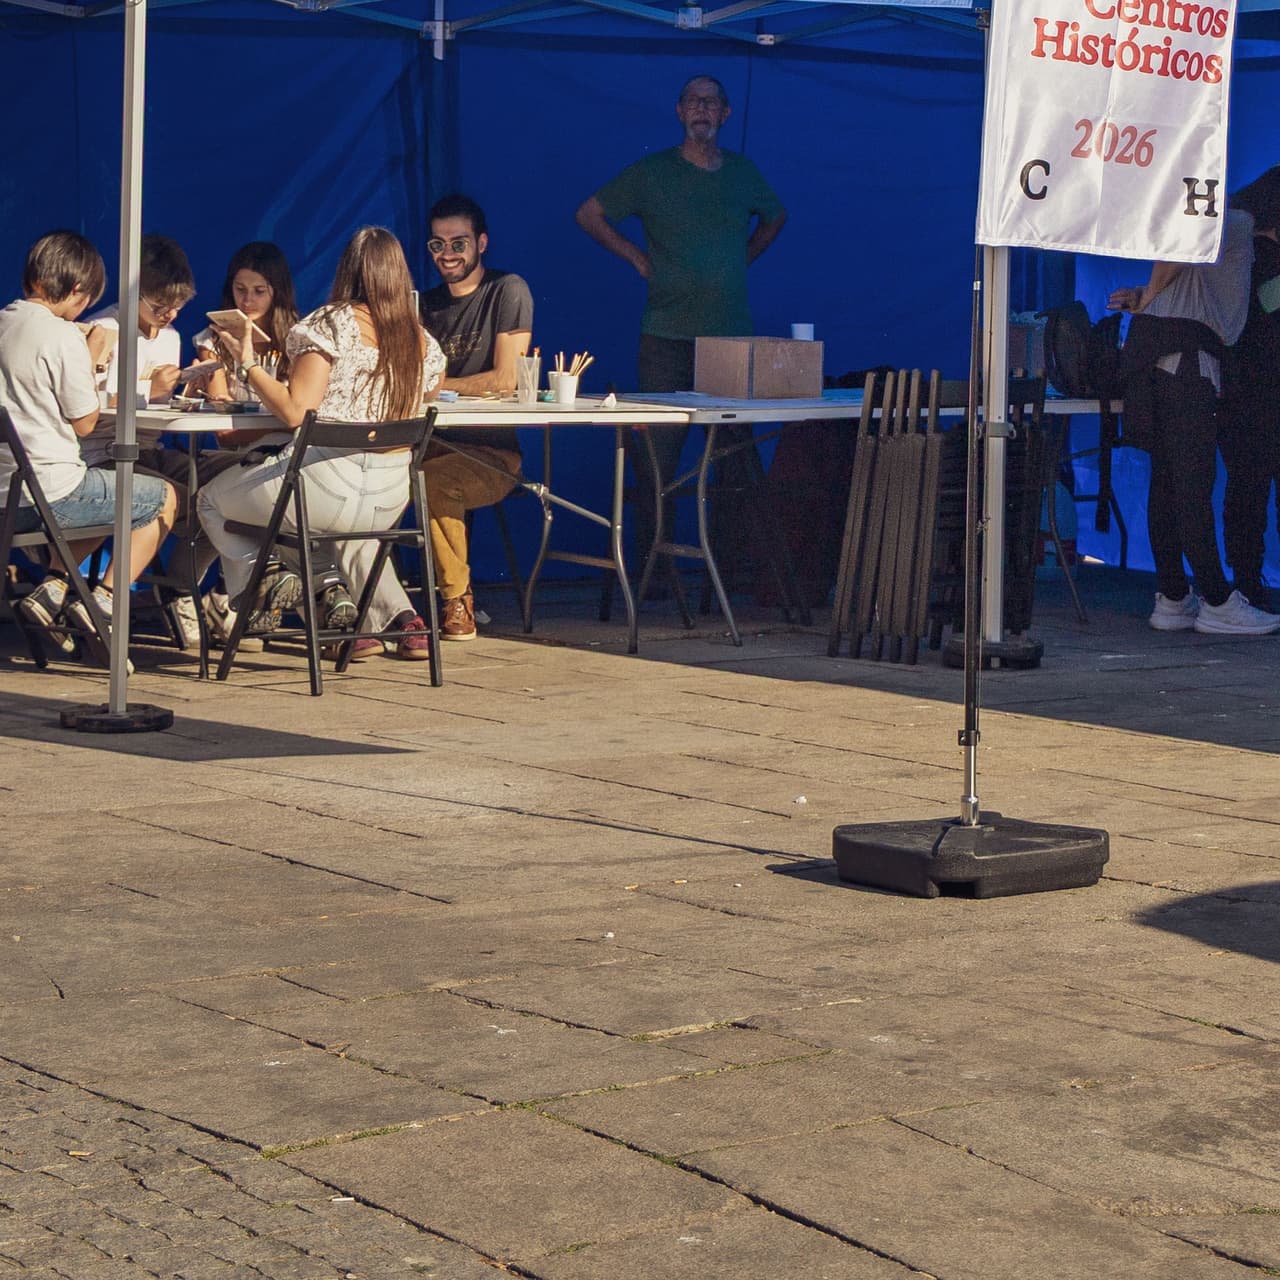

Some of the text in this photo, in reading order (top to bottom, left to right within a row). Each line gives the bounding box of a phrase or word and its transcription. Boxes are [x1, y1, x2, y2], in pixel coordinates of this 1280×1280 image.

[1031, 16, 1224, 85] Históricos
[1070, 117, 1159, 168] 2026
[1019, 158, 1220, 218] C H
